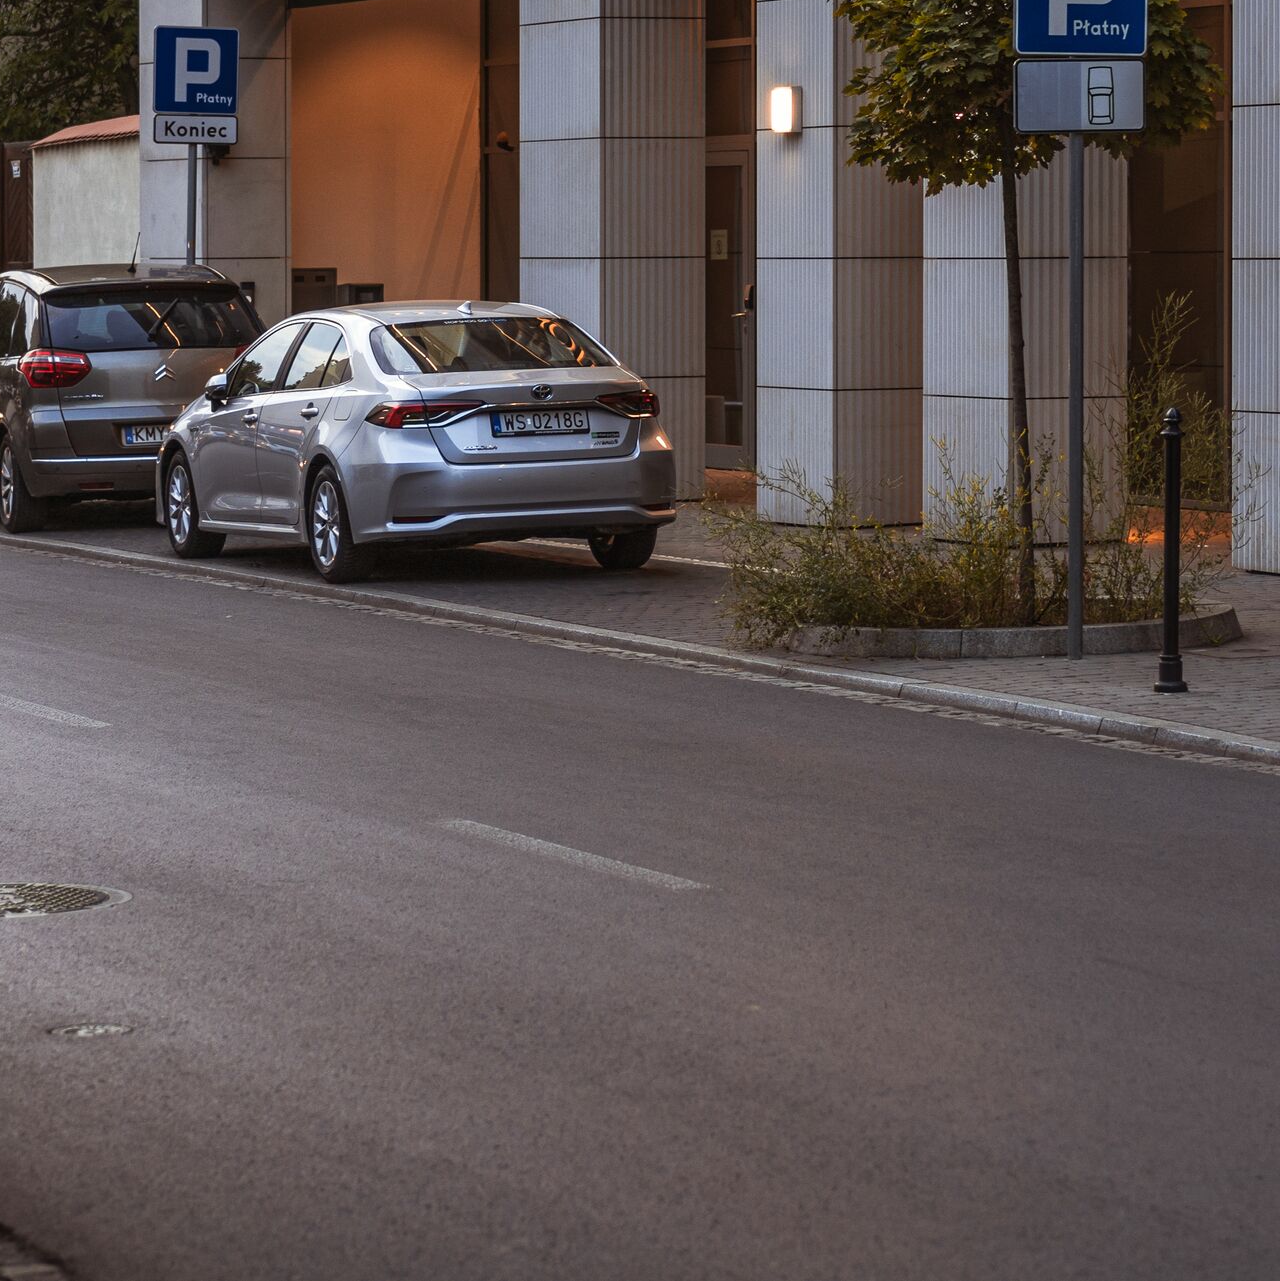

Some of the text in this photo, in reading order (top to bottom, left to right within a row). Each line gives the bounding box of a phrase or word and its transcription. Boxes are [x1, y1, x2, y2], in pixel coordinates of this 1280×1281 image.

[1073, 20, 1129, 40] Płatny
[174, 37, 221, 102] P
[196, 93, 233, 106] Płatny
[164, 121, 228, 138] Koniec
[504, 414, 525, 430] WS
[533, 411, 584, 429] 0218G
